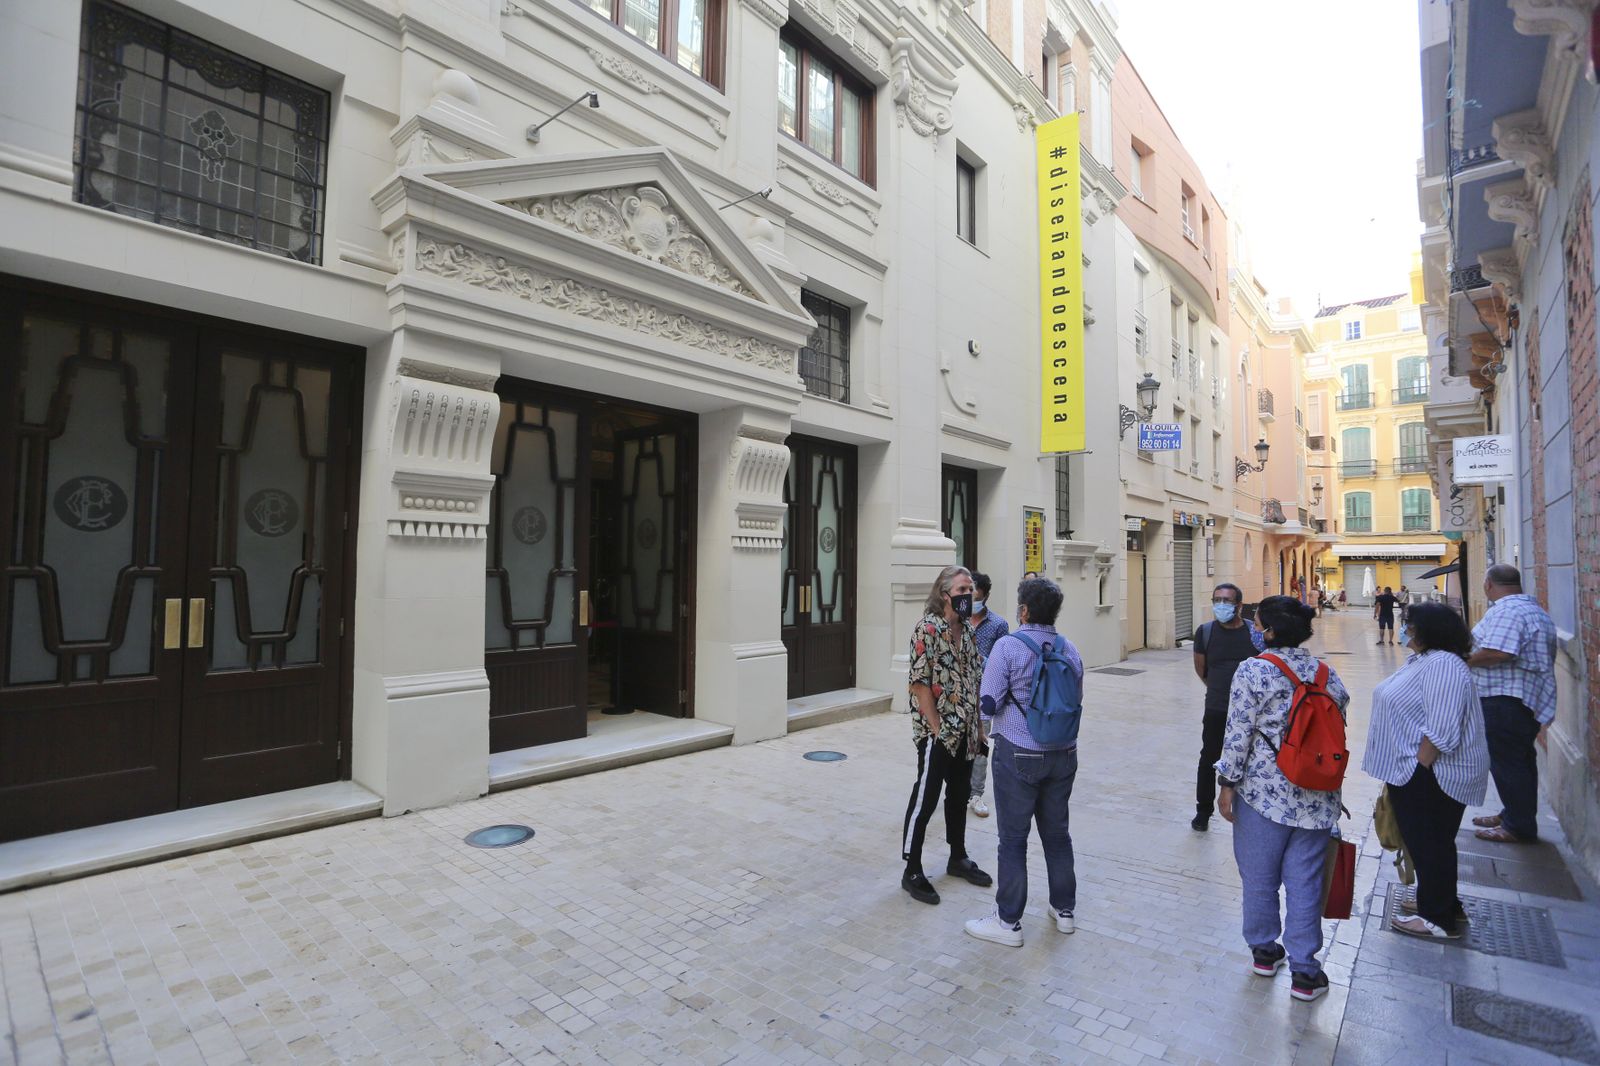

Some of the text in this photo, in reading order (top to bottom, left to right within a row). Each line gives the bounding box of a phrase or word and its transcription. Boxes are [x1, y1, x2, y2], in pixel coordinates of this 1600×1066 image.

[1050, 146, 1070, 424] #diseñandoescena
[1141, 440, 1179, 448] 952 60 61 14
